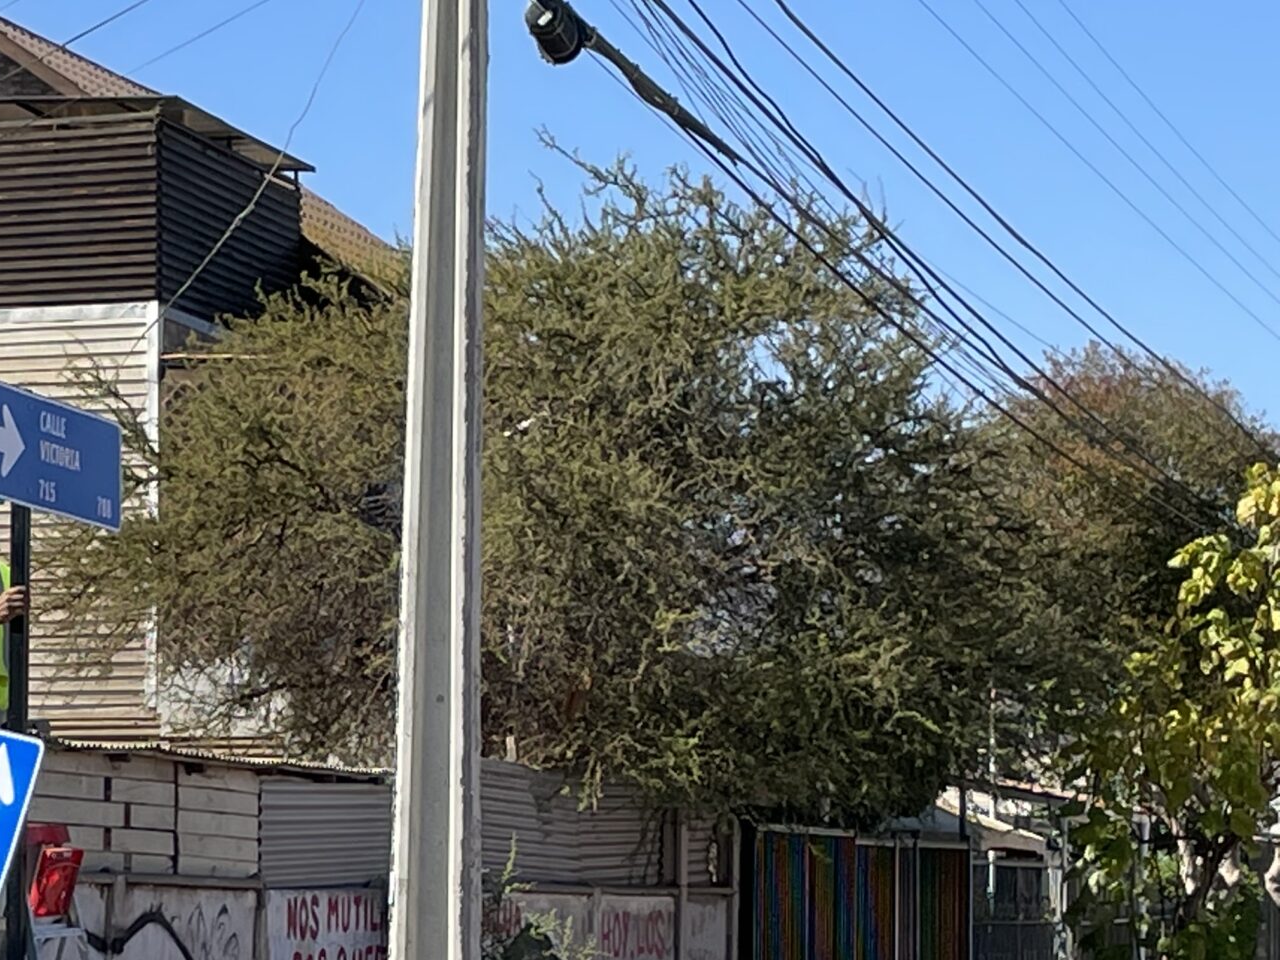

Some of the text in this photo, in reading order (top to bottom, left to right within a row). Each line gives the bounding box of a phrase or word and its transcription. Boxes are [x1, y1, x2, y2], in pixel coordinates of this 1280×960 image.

[40, 411, 66, 438] CALLE
[40, 440, 80, 471] VICTORIA
[38, 479, 56, 502] 715
[286, 894, 320, 941] NOS
